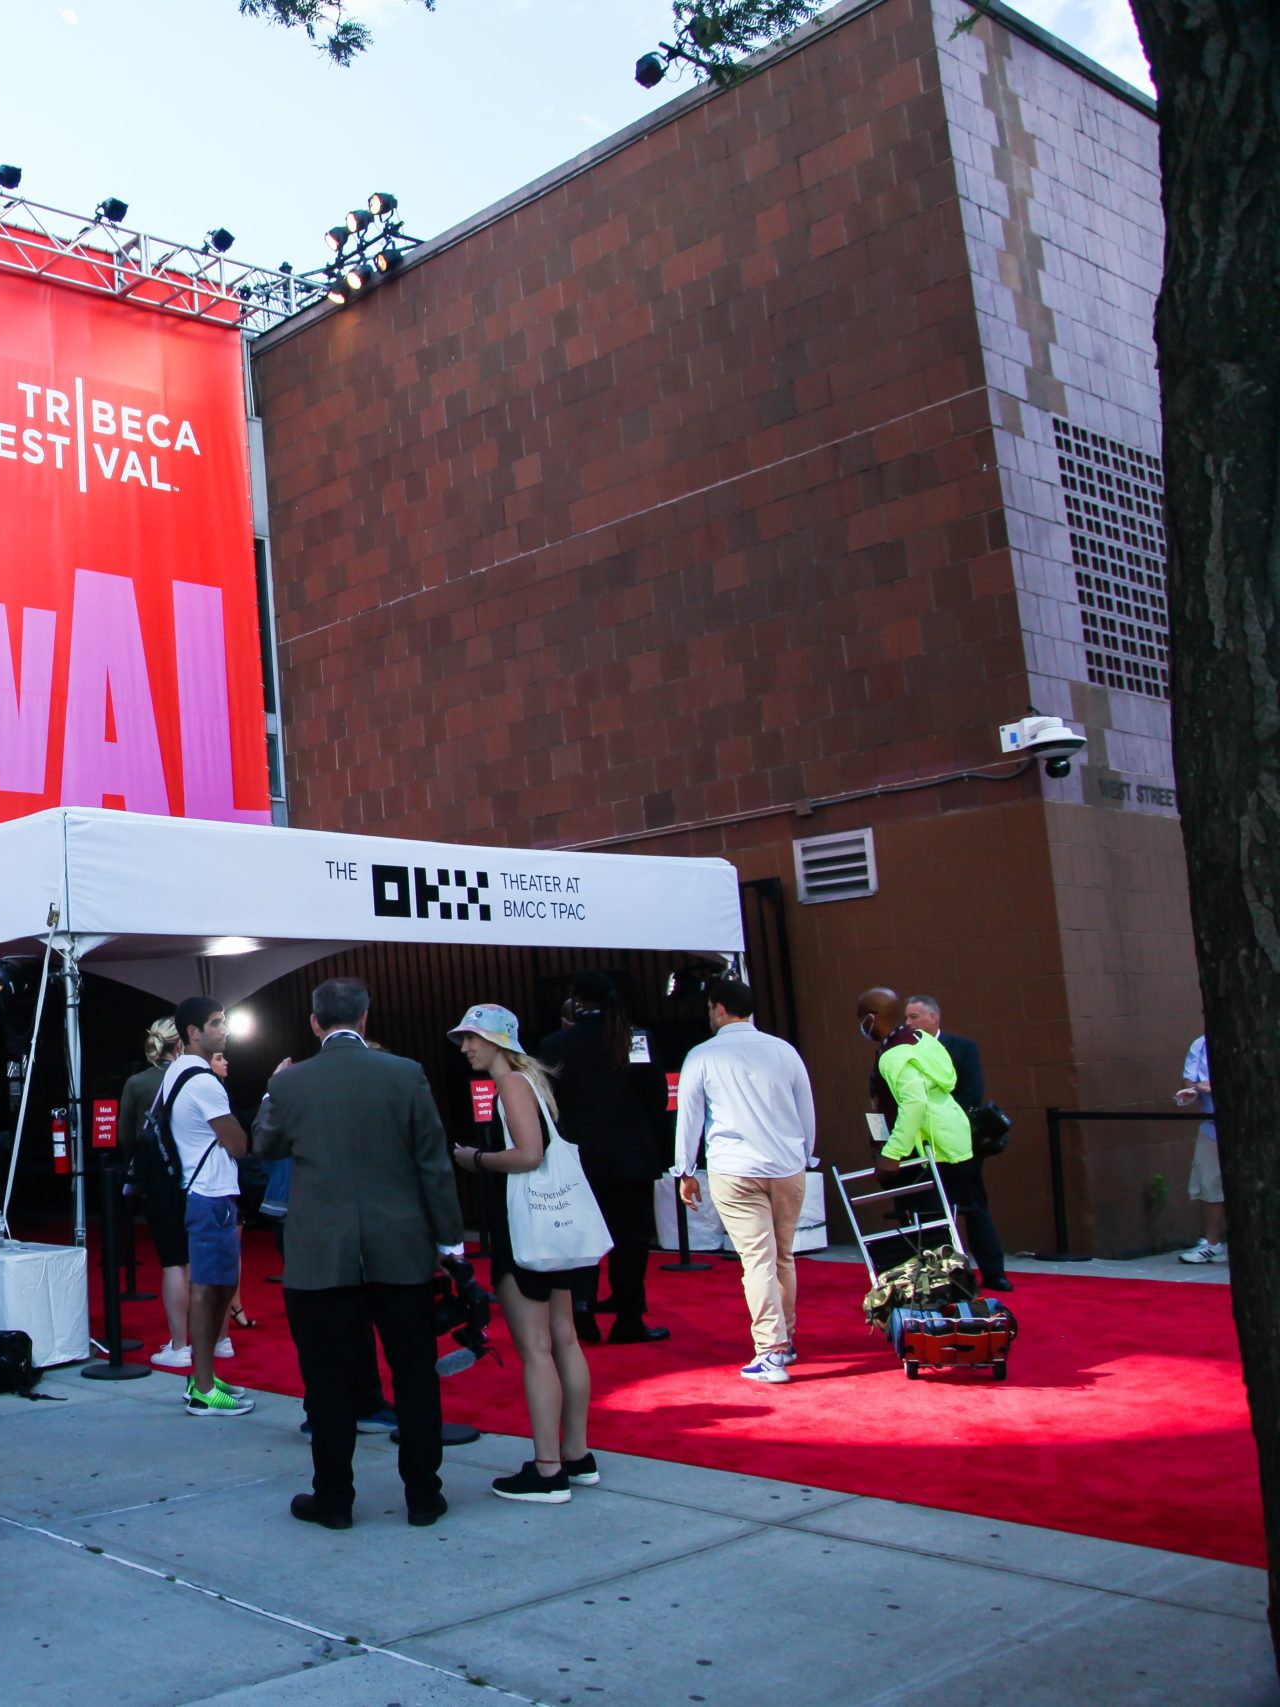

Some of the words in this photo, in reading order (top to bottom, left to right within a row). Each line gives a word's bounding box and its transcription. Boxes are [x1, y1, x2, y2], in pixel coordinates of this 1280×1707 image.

[1097, 777, 1132, 801] WEST
[1136, 784, 1176, 807] STREE
[325, 861, 358, 881] THE
[372, 864, 491, 921] OKX
[500, 873, 561, 893] THEATER
[566, 877, 580, 894] AT
[504, 900, 546, 919] BMCC
[551, 902, 586, 921] TPAC
